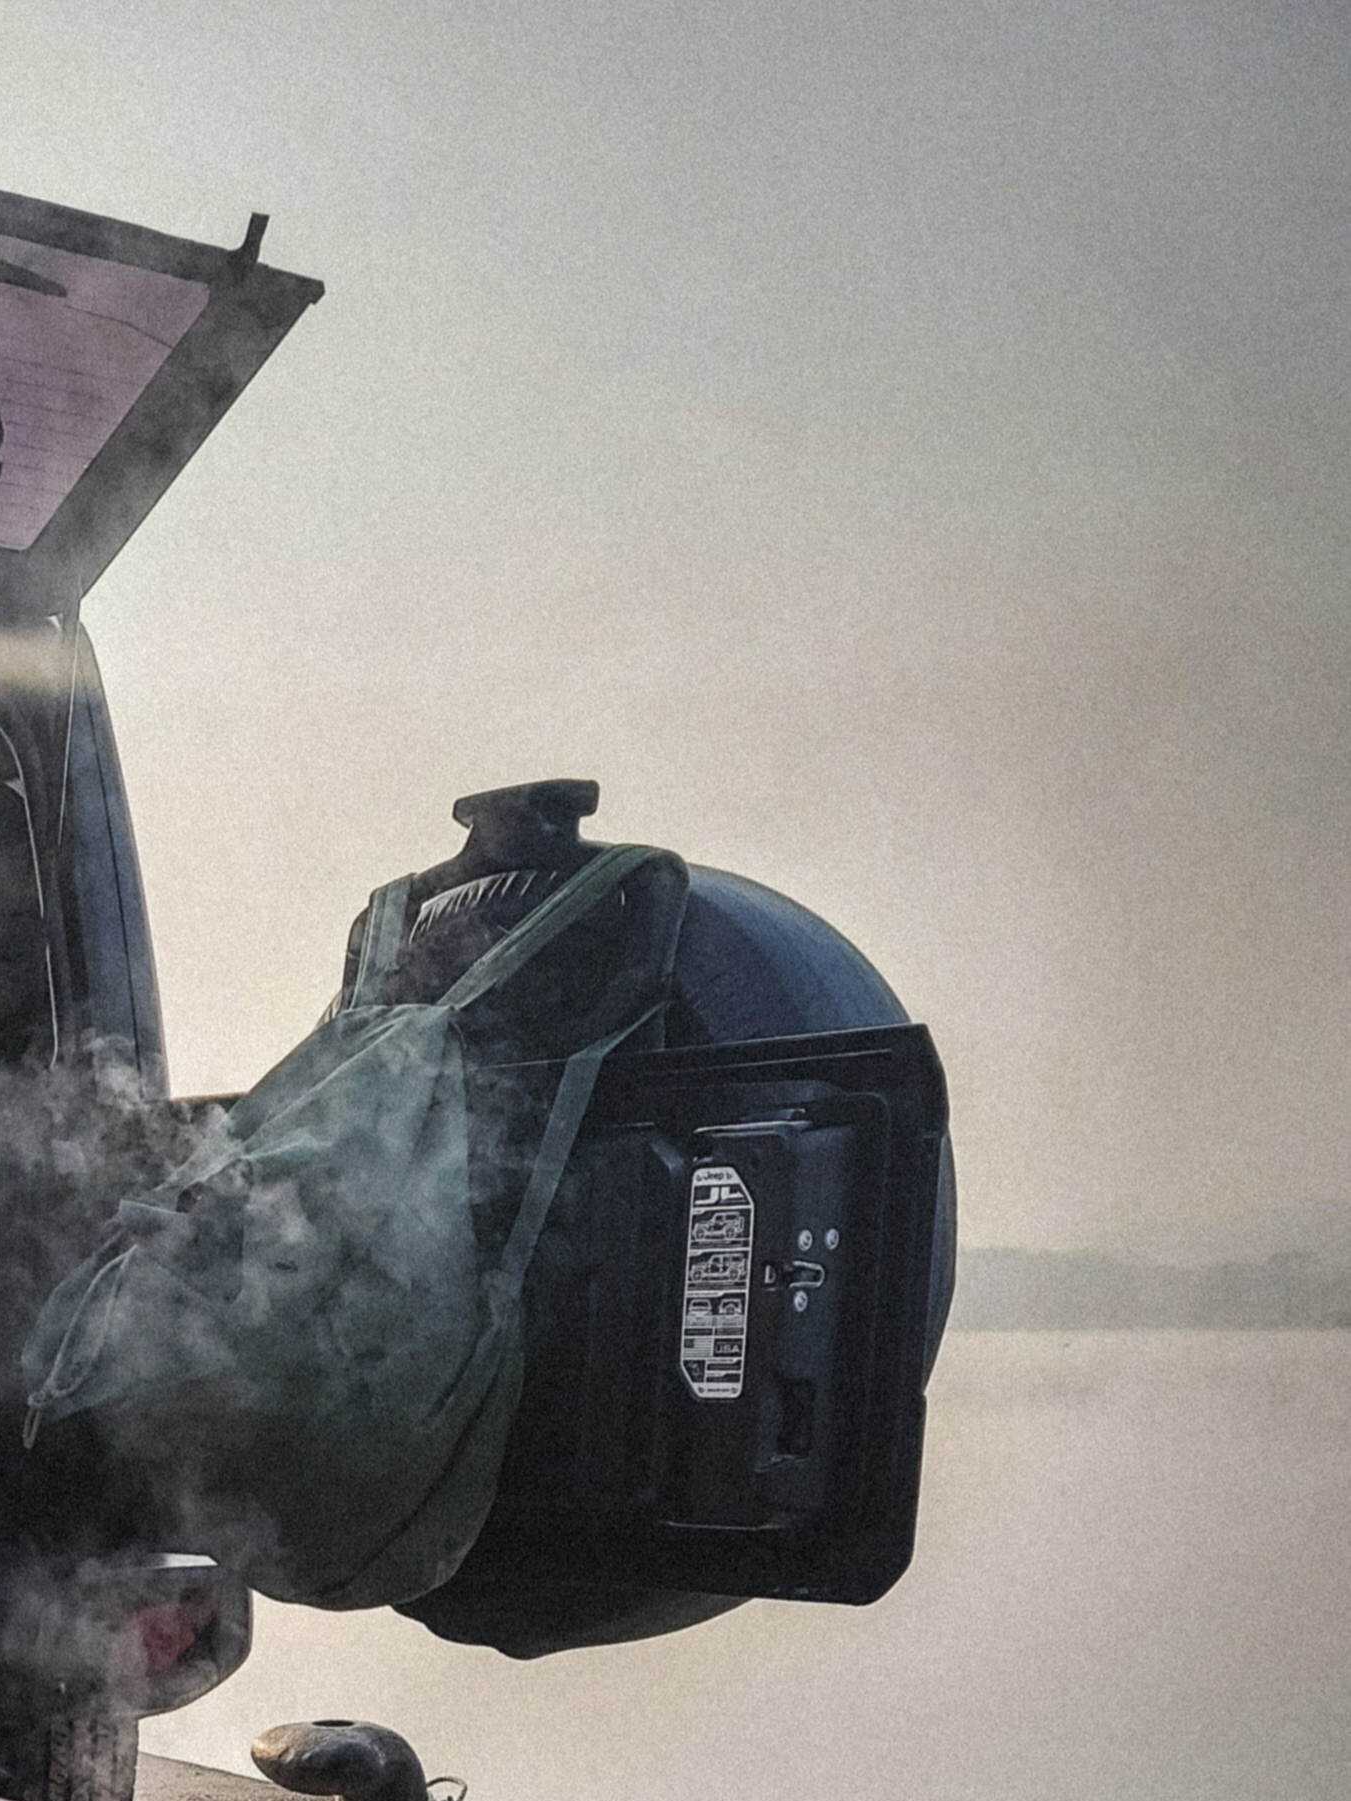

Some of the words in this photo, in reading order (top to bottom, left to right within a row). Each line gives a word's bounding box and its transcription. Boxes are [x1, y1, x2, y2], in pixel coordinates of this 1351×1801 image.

[703, 1171, 725, 1181] Jeep
[694, 1186, 745, 1205] JL
[715, 1344, 742, 1354] USA
